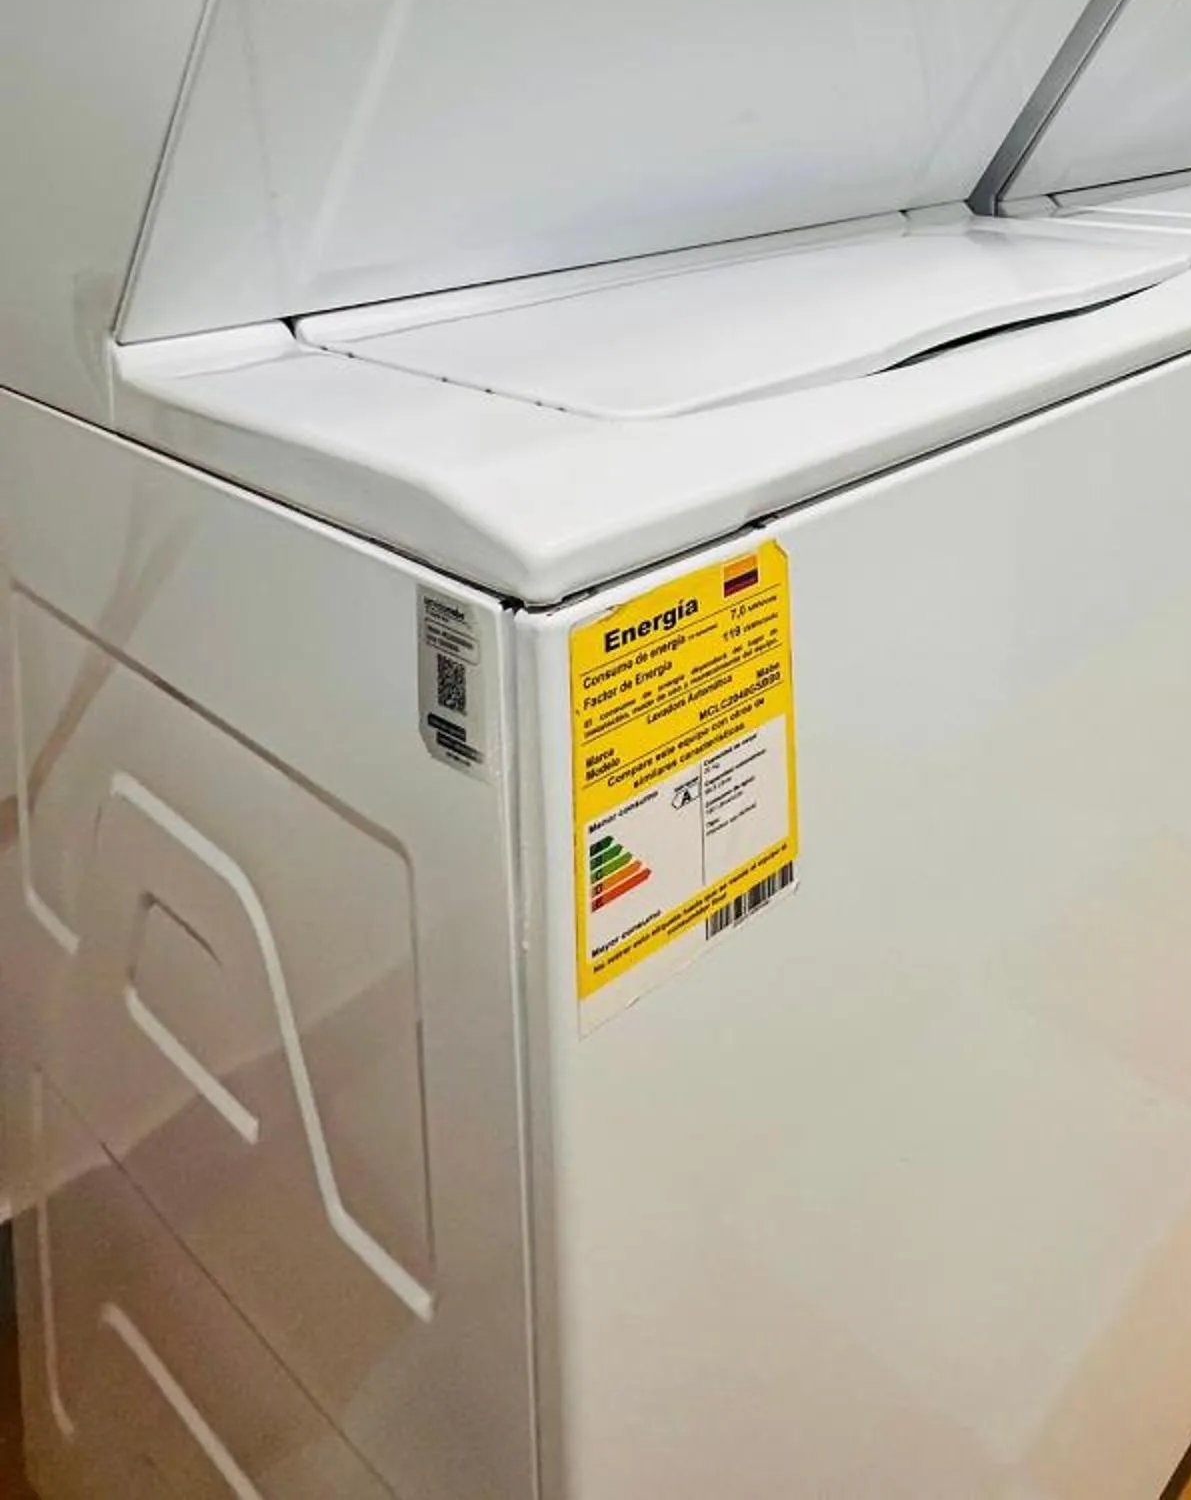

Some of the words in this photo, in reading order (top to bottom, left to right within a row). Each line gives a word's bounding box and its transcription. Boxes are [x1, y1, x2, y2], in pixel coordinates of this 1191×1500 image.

[603, 598, 699, 654] Energía
[583, 658, 633, 690] Consumo
[635, 652, 649, 666] de
[583, 687, 618, 711] Factor
[619, 679, 633, 693] de
[646, 699, 687, 725] Lavadora
[585, 748, 615, 768] Marca
[607, 757, 653, 787] Compare
[655, 745, 677, 761] este
[677, 726, 710, 750] equipo
[711, 717, 730, 732] con
[585, 757, 622, 781] Modelo
[633, 759, 678, 789] similares
[681, 787, 692, 805] A
[588, 813, 617, 834] Menor
[617, 790, 660, 817] consumo
[591, 935, 620, 959] Mayor
[620, 908, 662, 939] consumo
[607, 946, 632, 966] retirar
